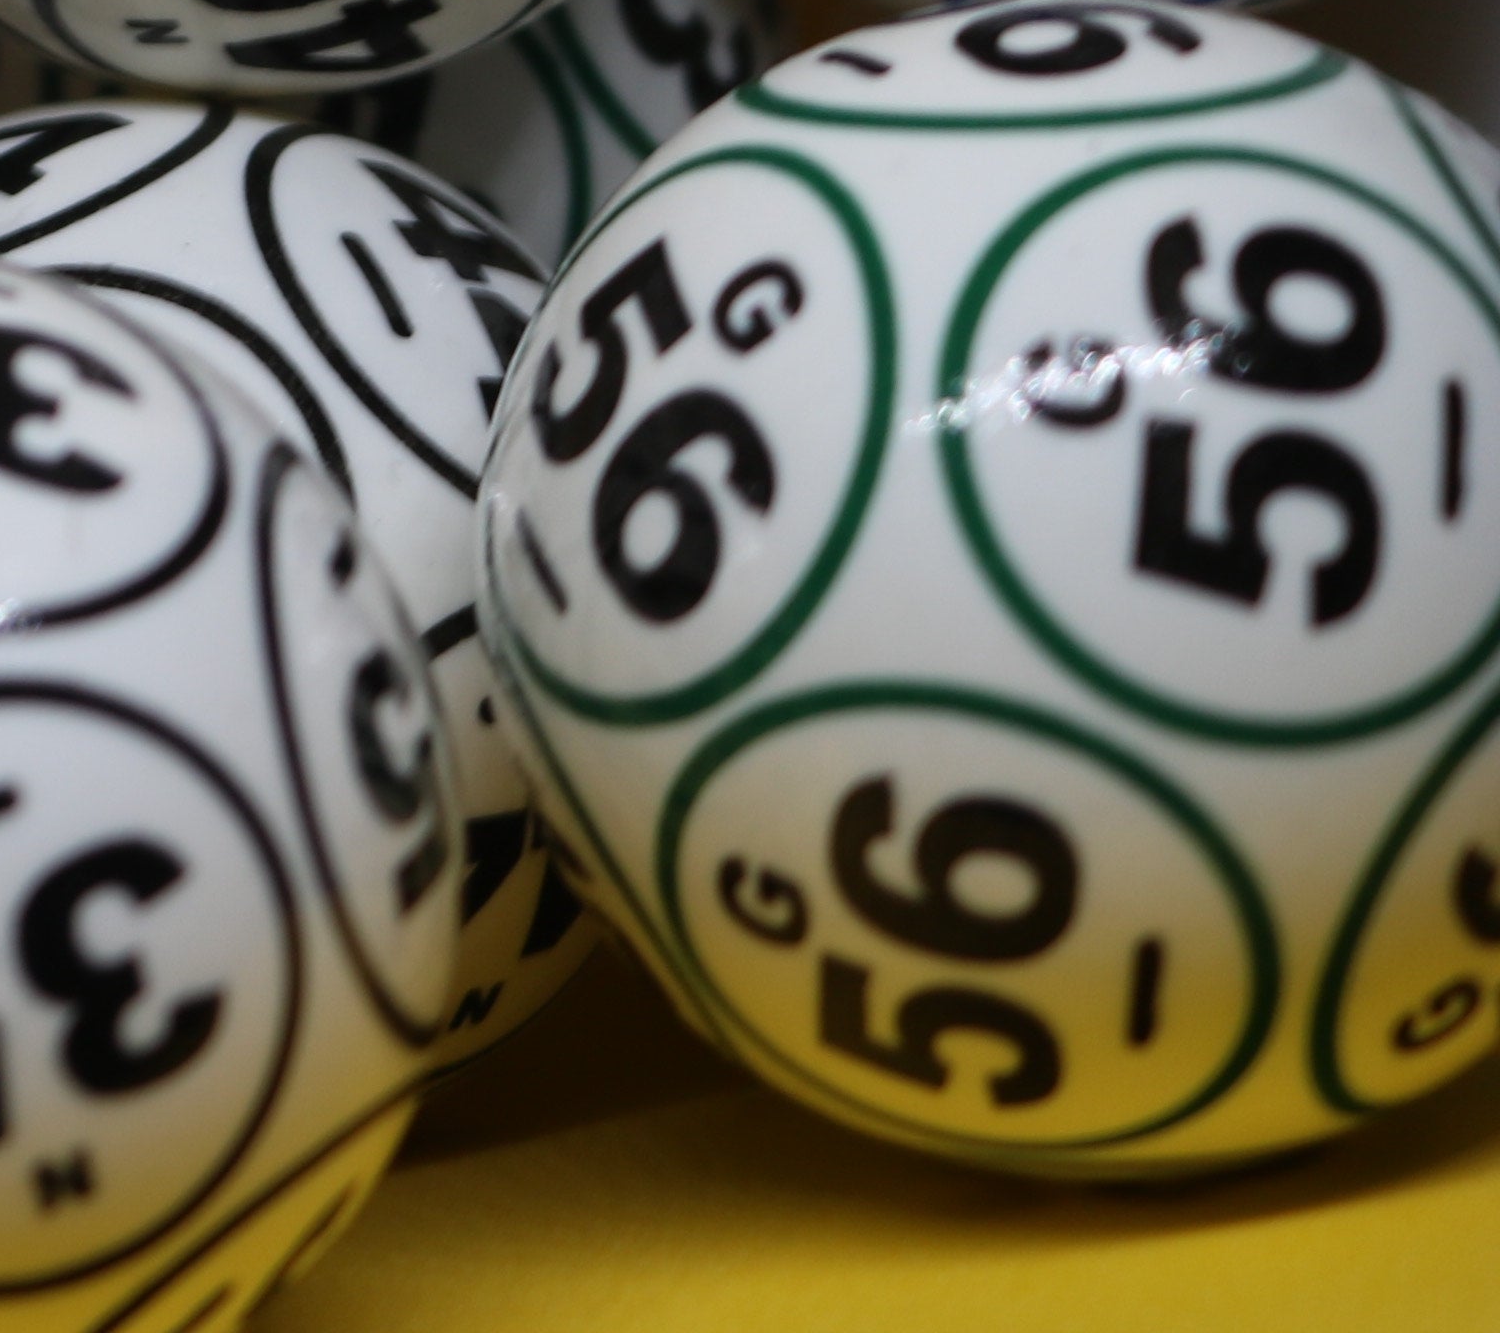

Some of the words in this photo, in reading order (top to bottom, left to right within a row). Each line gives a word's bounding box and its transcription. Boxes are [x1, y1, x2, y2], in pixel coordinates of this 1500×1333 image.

[952, 1, 1204, 80] 6
[710, 256, 806, 356] G
[530, 236, 779, 629] 56
[1129, 213, 1390, 634] 56
[714, 852, 812, 951] G
[818, 772, 1083, 1113] 56
[28, 1145, 98, 1215] N
